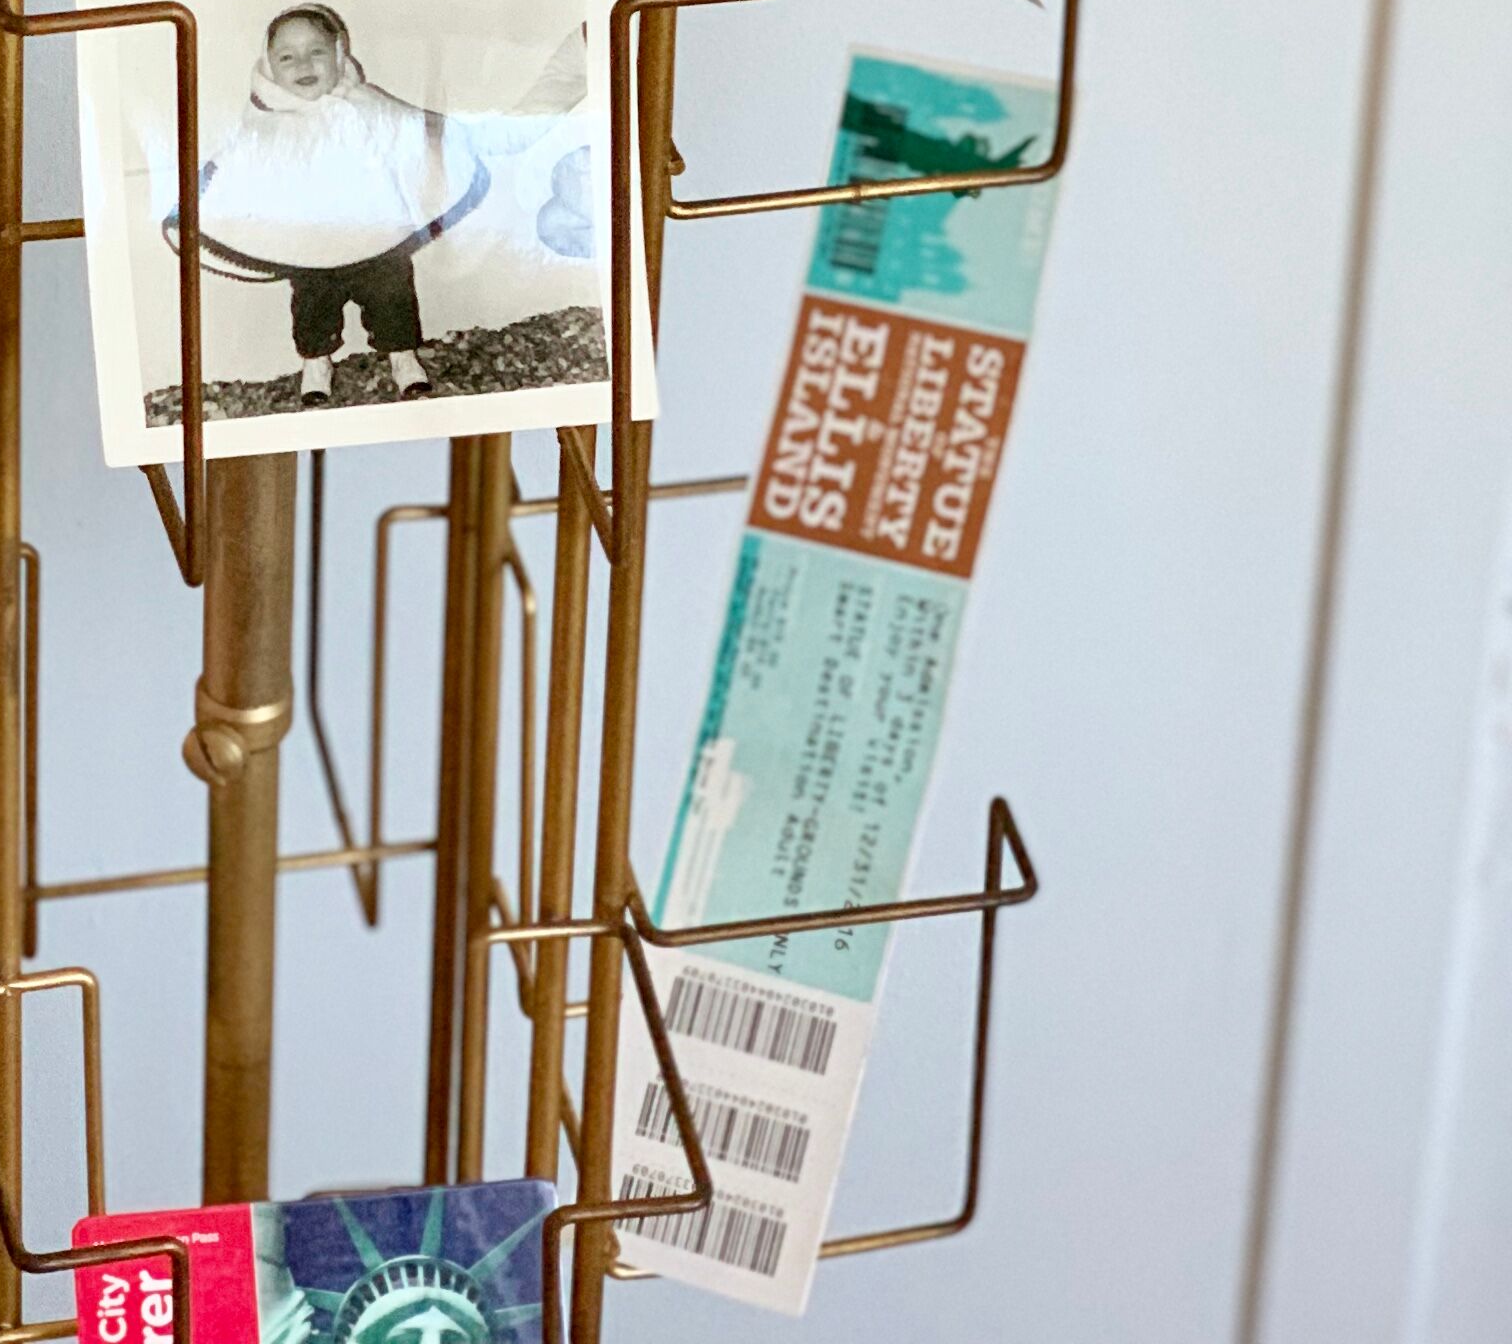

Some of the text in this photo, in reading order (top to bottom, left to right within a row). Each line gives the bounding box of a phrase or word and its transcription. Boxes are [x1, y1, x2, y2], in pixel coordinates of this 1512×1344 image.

[763, 309, 844, 521] ISLAND
[798, 316, 889, 531] ELLIS
[878, 335, 955, 550] LIBERTY
[921, 343, 1004, 561] STATUE
[765, 931, 789, 975] NLY
[832, 820, 879, 953] 12/31/216
[96, 1273, 131, 1343] City
